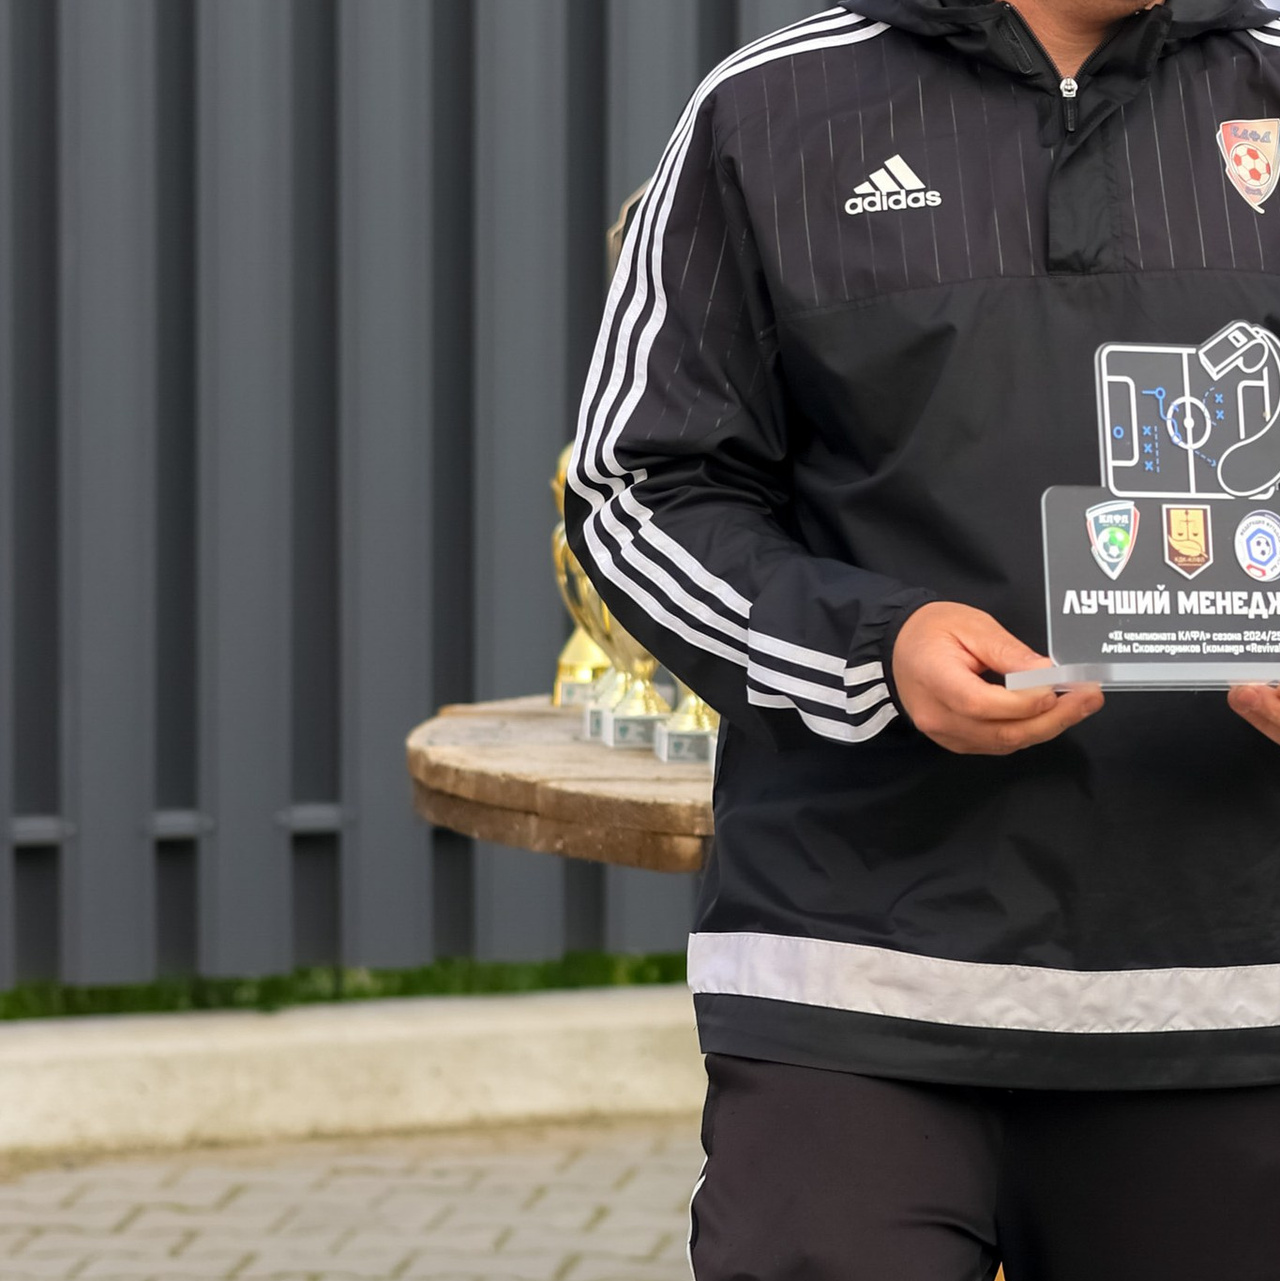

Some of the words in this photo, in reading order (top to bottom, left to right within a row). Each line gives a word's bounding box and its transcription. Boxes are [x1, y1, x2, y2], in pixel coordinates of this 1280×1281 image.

[844, 189, 942, 215] adidas
[1062, 584, 1171, 615] ЛУЧШИЙ
[1124, 631, 1177, 641] чемпионата
[1178, 630, 1211, 641] КЛФЛ»
[1212, 631, 1242, 641] сезона
[1101, 642, 1131, 653] Артём
